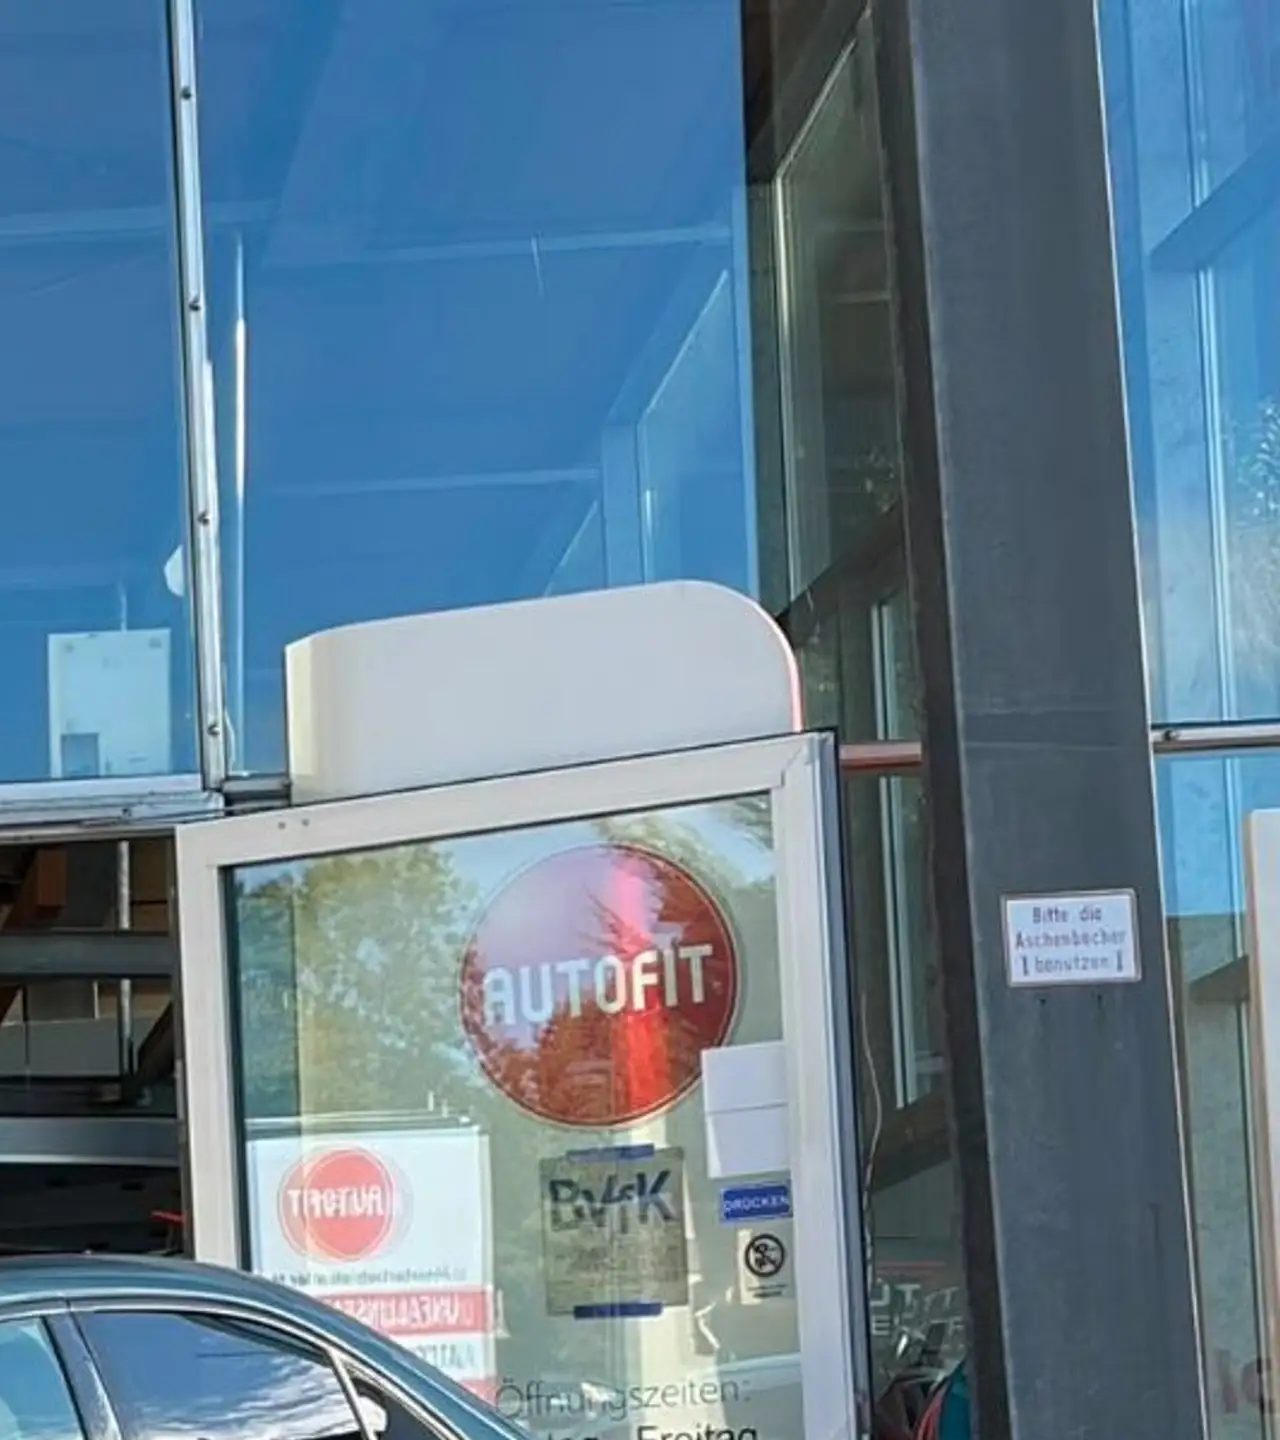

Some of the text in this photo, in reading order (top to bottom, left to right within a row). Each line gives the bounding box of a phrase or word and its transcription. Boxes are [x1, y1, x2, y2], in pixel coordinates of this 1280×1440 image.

[1033, 905, 1102, 924] Bitte die
[483, 944, 713, 1027] AUTOFIT
[495, 1377, 752, 1420] Öffnungszeiten:
